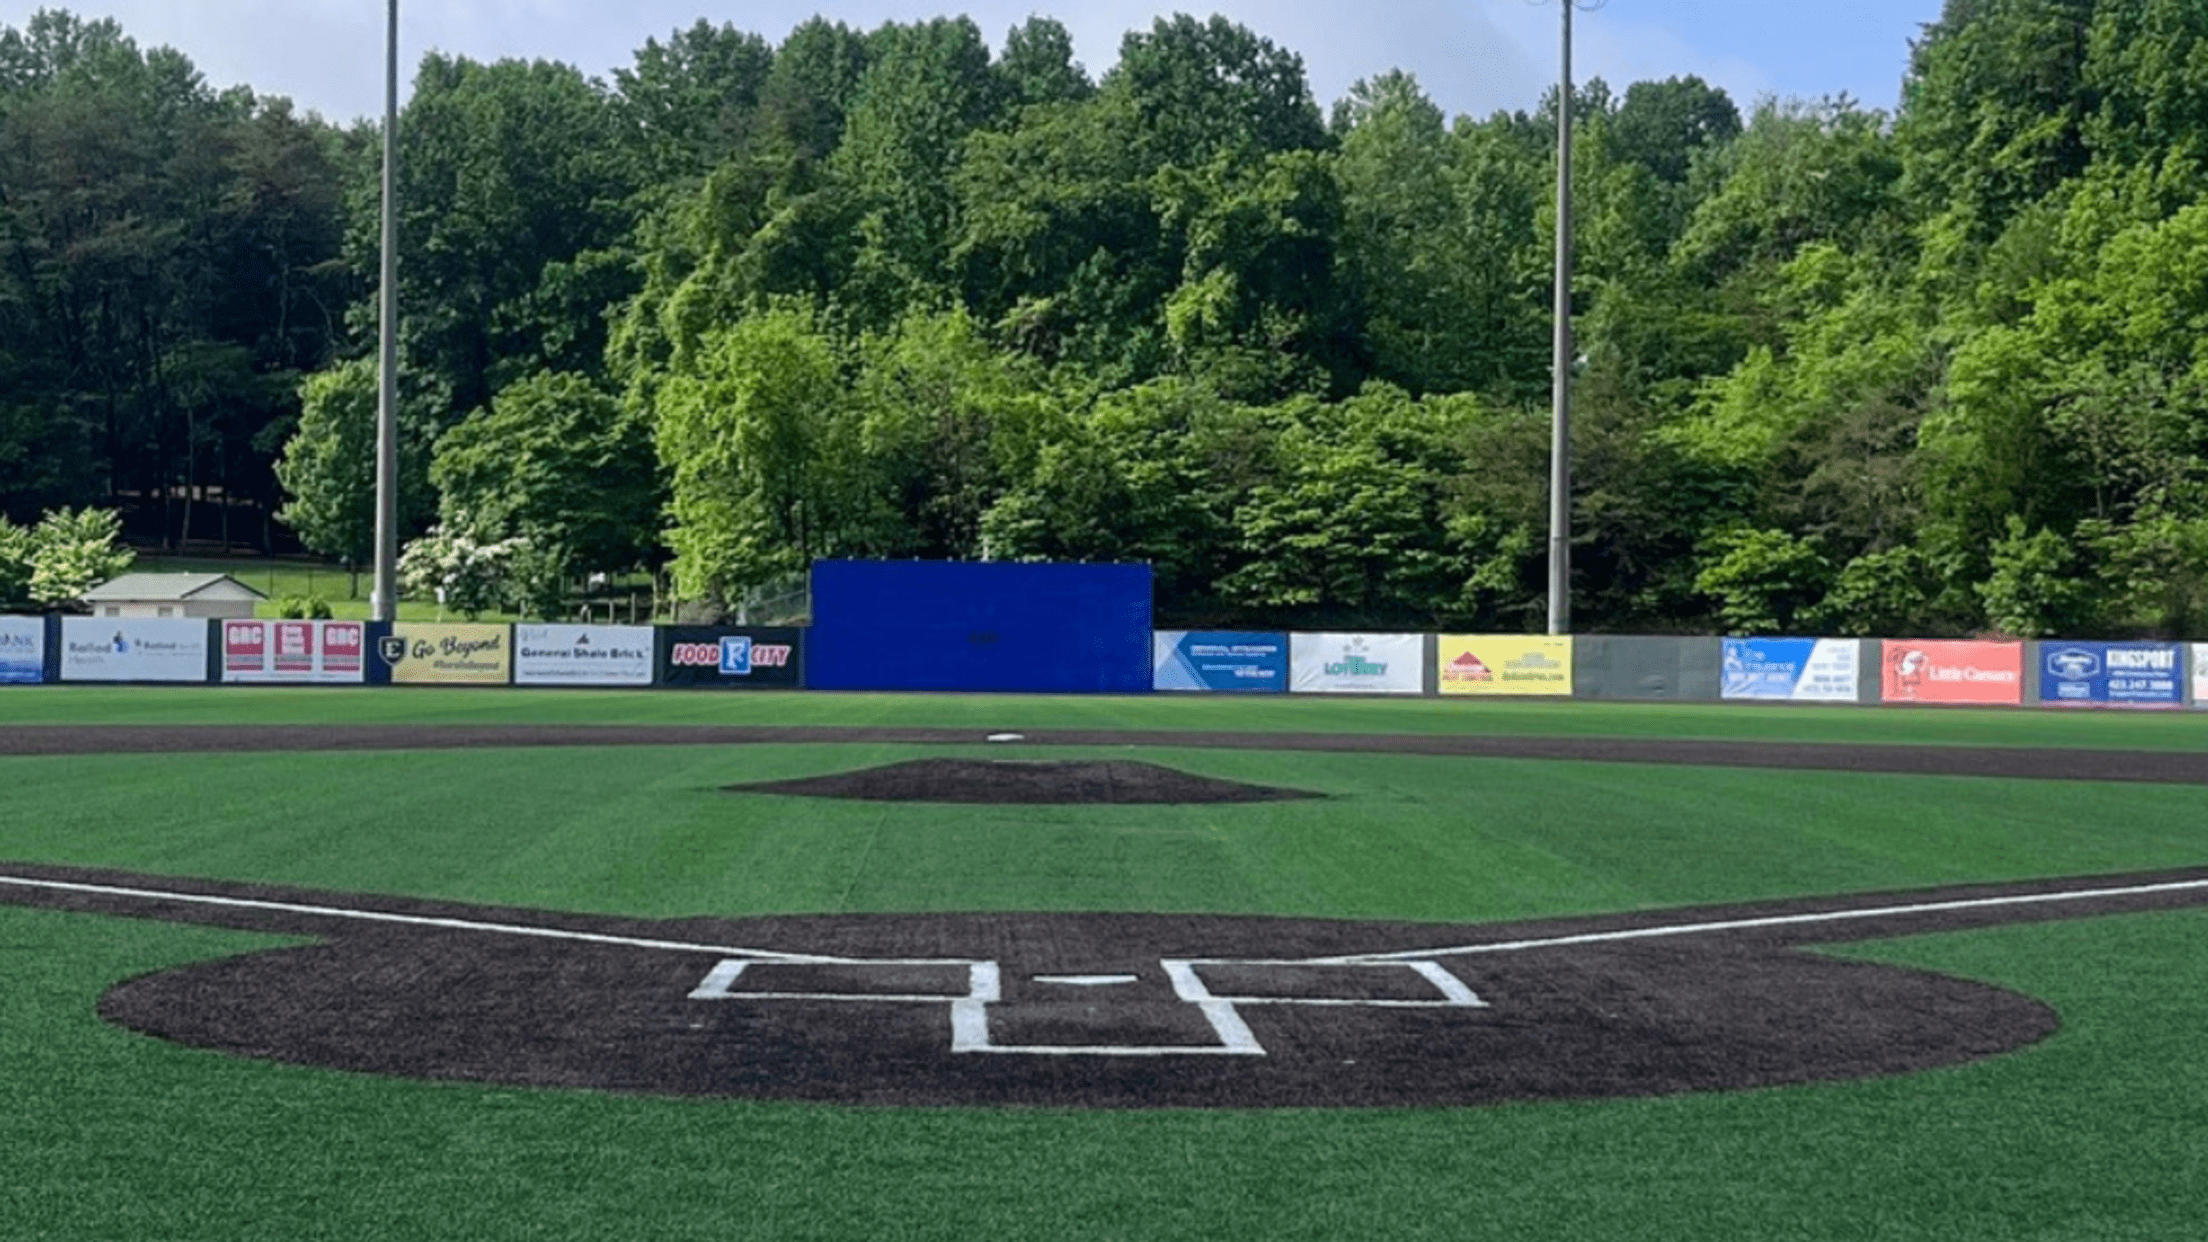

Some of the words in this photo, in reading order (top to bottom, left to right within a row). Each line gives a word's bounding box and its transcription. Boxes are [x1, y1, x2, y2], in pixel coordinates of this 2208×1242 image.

[412, 639, 436, 660] Go
[440, 634, 500, 658] Beyond
[521, 647, 571, 658] General
[573, 647, 609, 658] Shale
[610, 647, 644, 659] Brick
[671, 643, 719, 666] FOOD
[751, 643, 792, 667] CITY
[1324, 660, 1388, 676] LOTTERY
[2106, 650, 2174, 669] KINGSPORT
